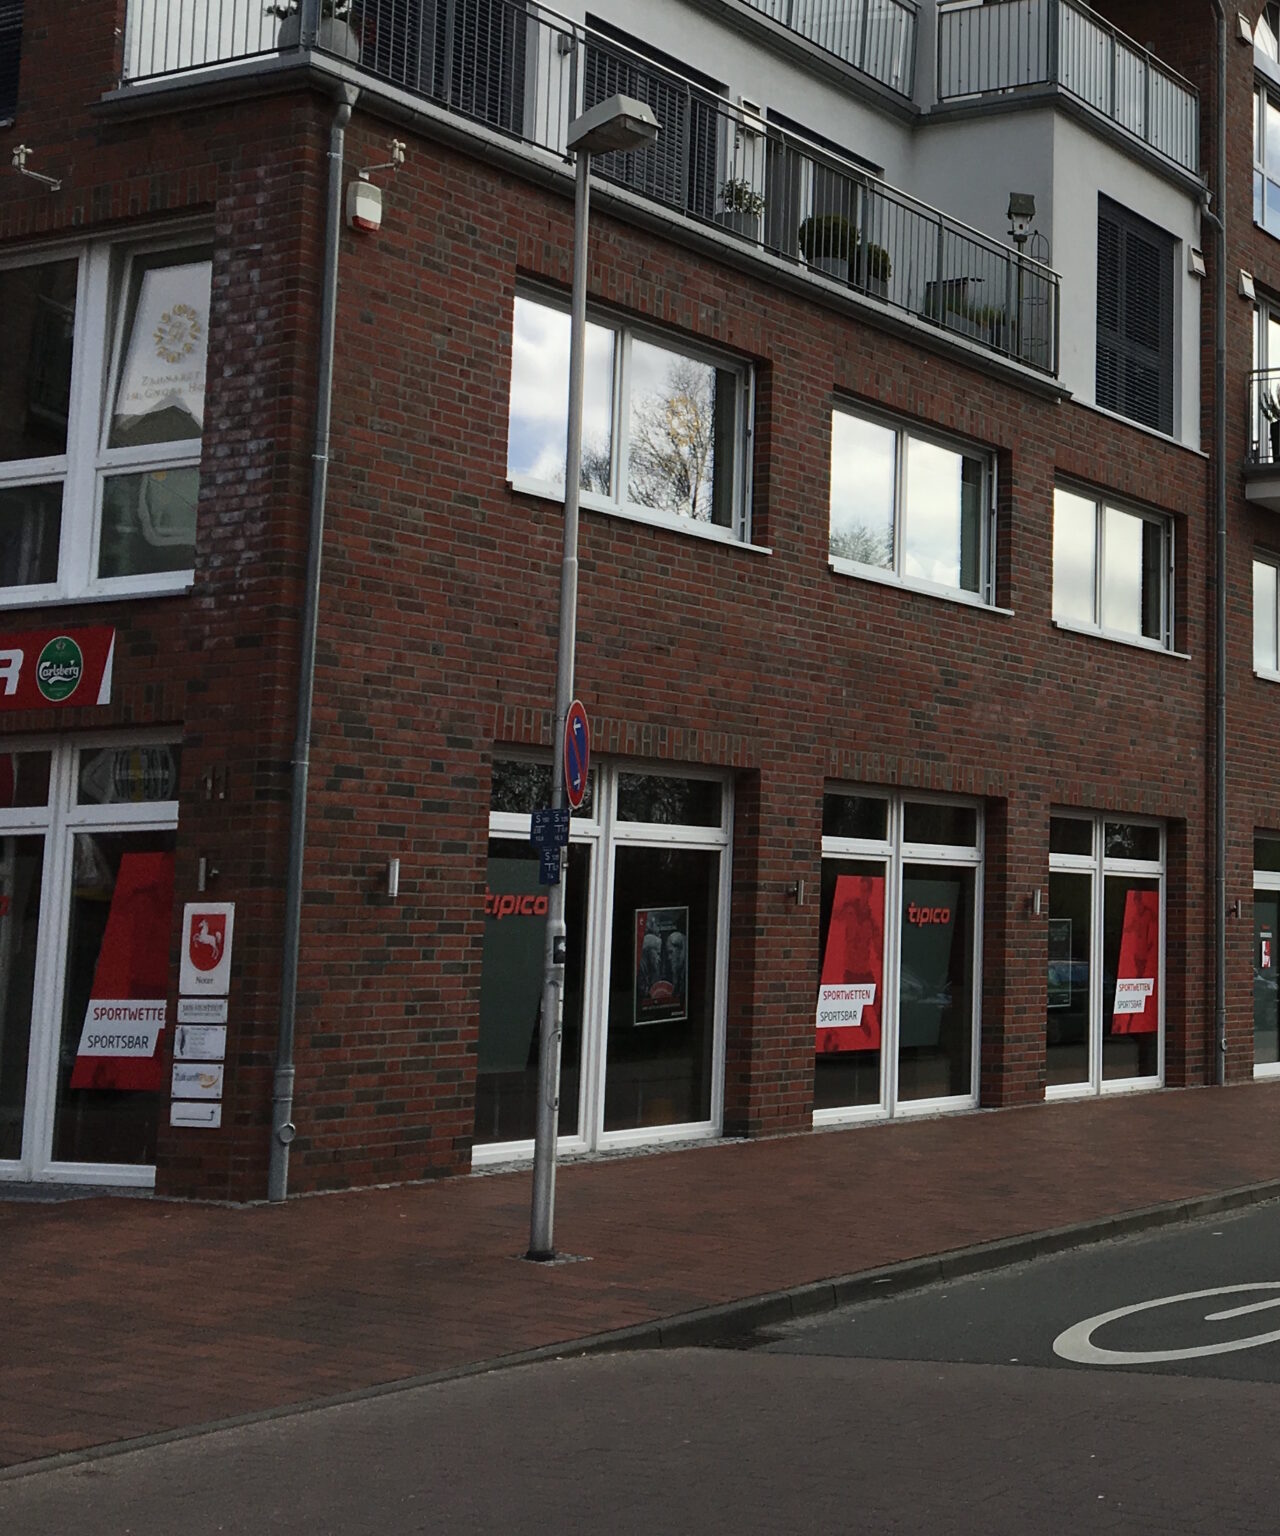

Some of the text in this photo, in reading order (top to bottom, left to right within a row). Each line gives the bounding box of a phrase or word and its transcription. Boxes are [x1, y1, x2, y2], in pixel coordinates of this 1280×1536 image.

[39, 660, 80, 682] Carlsberg
[908, 901, 951, 927] tipico
[1119, 983, 1151, 992] SPORTWETTEN
[823, 989, 871, 1001] SPORTWETTEN
[820, 1010, 858, 1022] SPORTSBAR
[87, 1035, 149, 1049] SPORTSBAR
